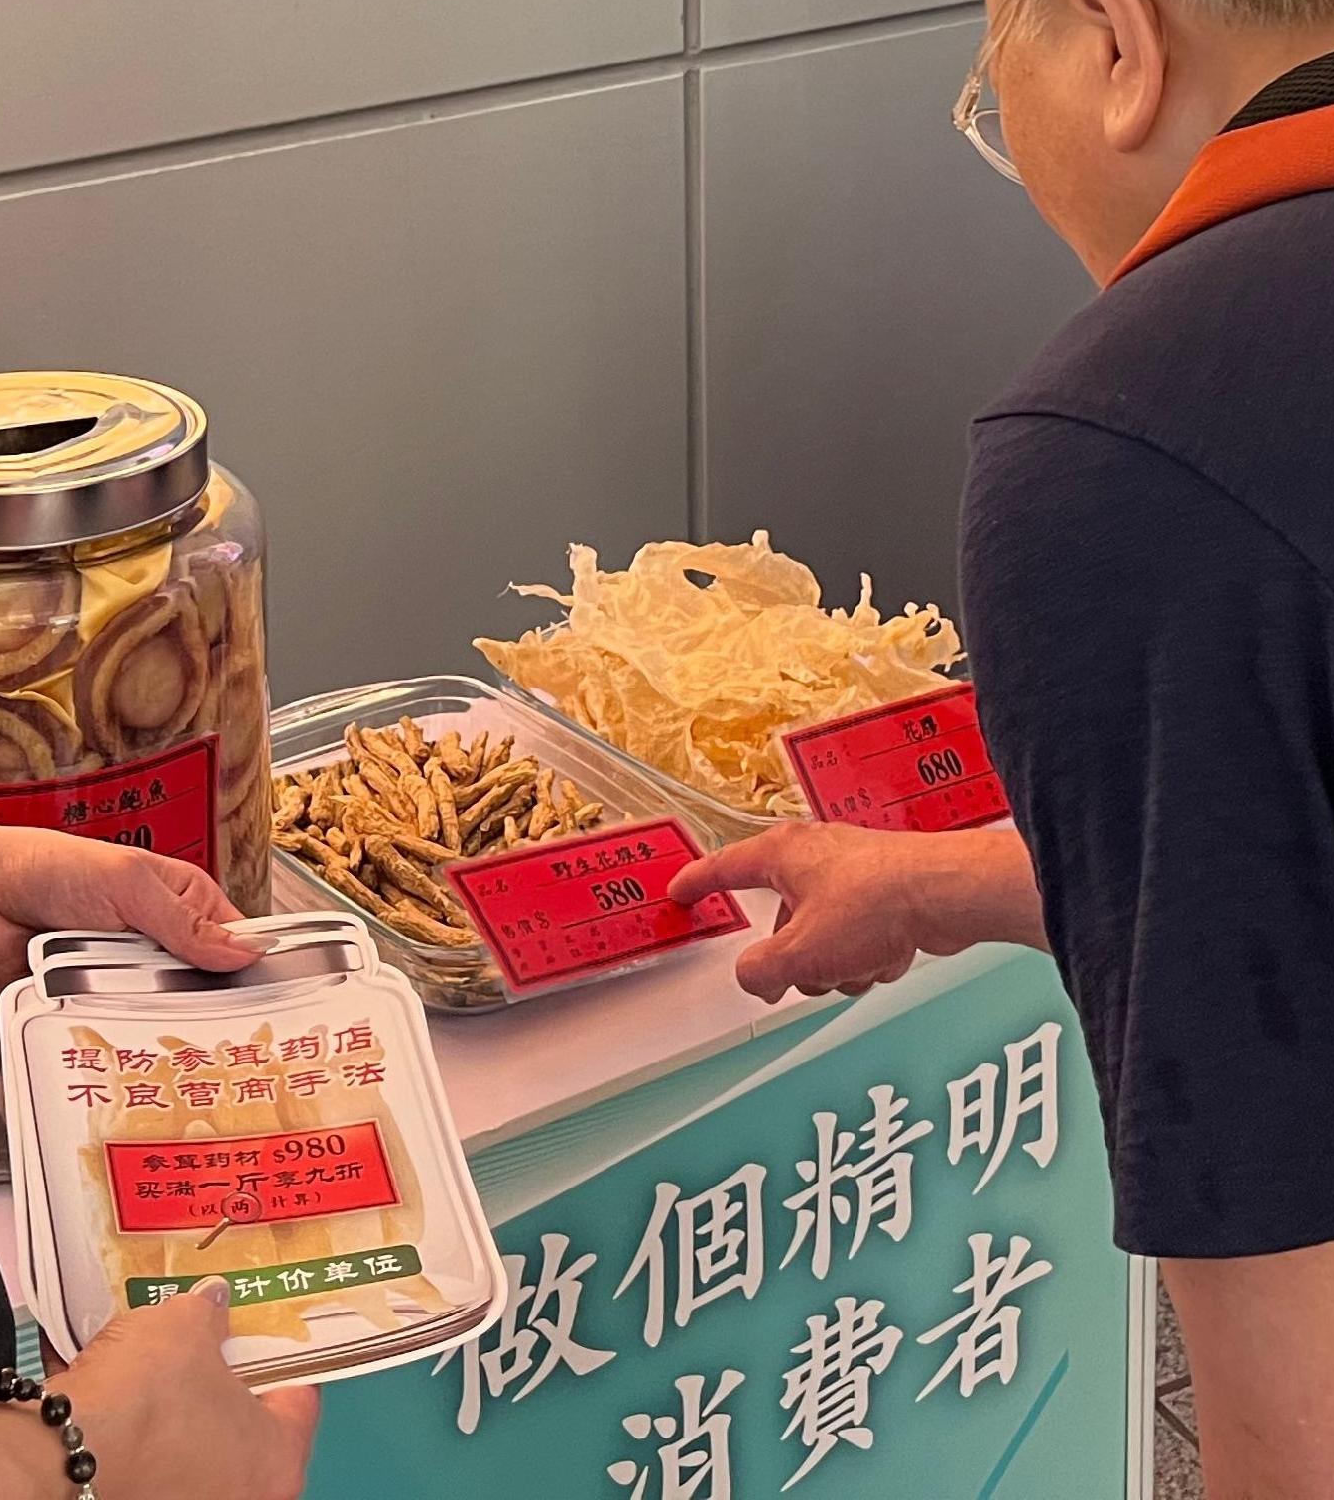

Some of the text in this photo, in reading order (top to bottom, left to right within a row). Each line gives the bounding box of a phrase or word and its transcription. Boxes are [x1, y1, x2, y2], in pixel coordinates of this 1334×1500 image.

[917, 748, 963, 786] 680
[591, 877, 645, 912] 580
[61, 1025, 373, 1073] 提防参茸药店
[67, 1062, 386, 1109] 不良营商手法
[134, 1161, 364, 1199] 买满一斤享九折
[432, 1020, 1063, 1434] 做個精明
[147, 1253, 402, 1305] 混计价单位
[607, 1232, 1053, 1500] 消費者
